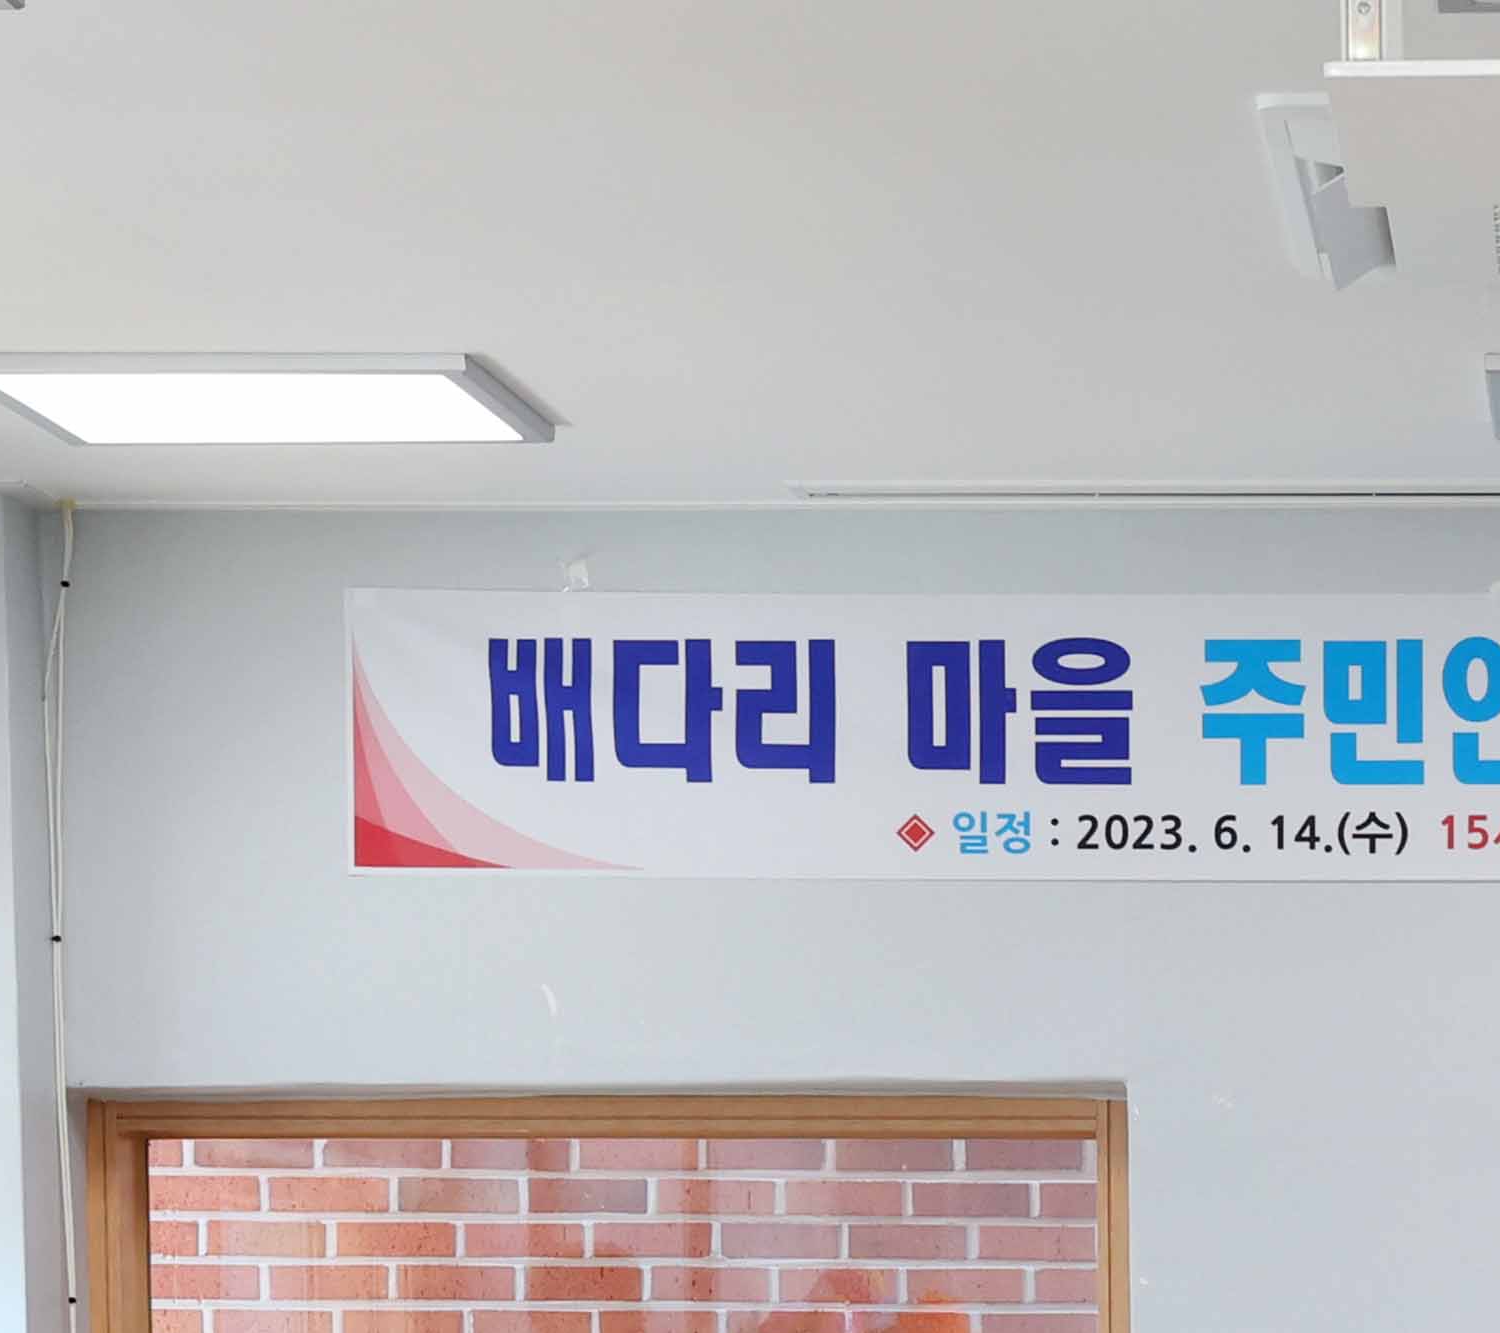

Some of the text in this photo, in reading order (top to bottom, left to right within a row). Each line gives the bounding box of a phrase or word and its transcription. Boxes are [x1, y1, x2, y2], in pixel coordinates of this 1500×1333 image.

[488, 637, 836, 785] 배다리
[906, 636, 1133, 786] 마을
[953, 810, 1032, 855] 일정
[1076, 813, 1198, 854] 2023.
[1213, 814, 1252, 854] 6.
[1270, 811, 1409, 856] 14.(수)
